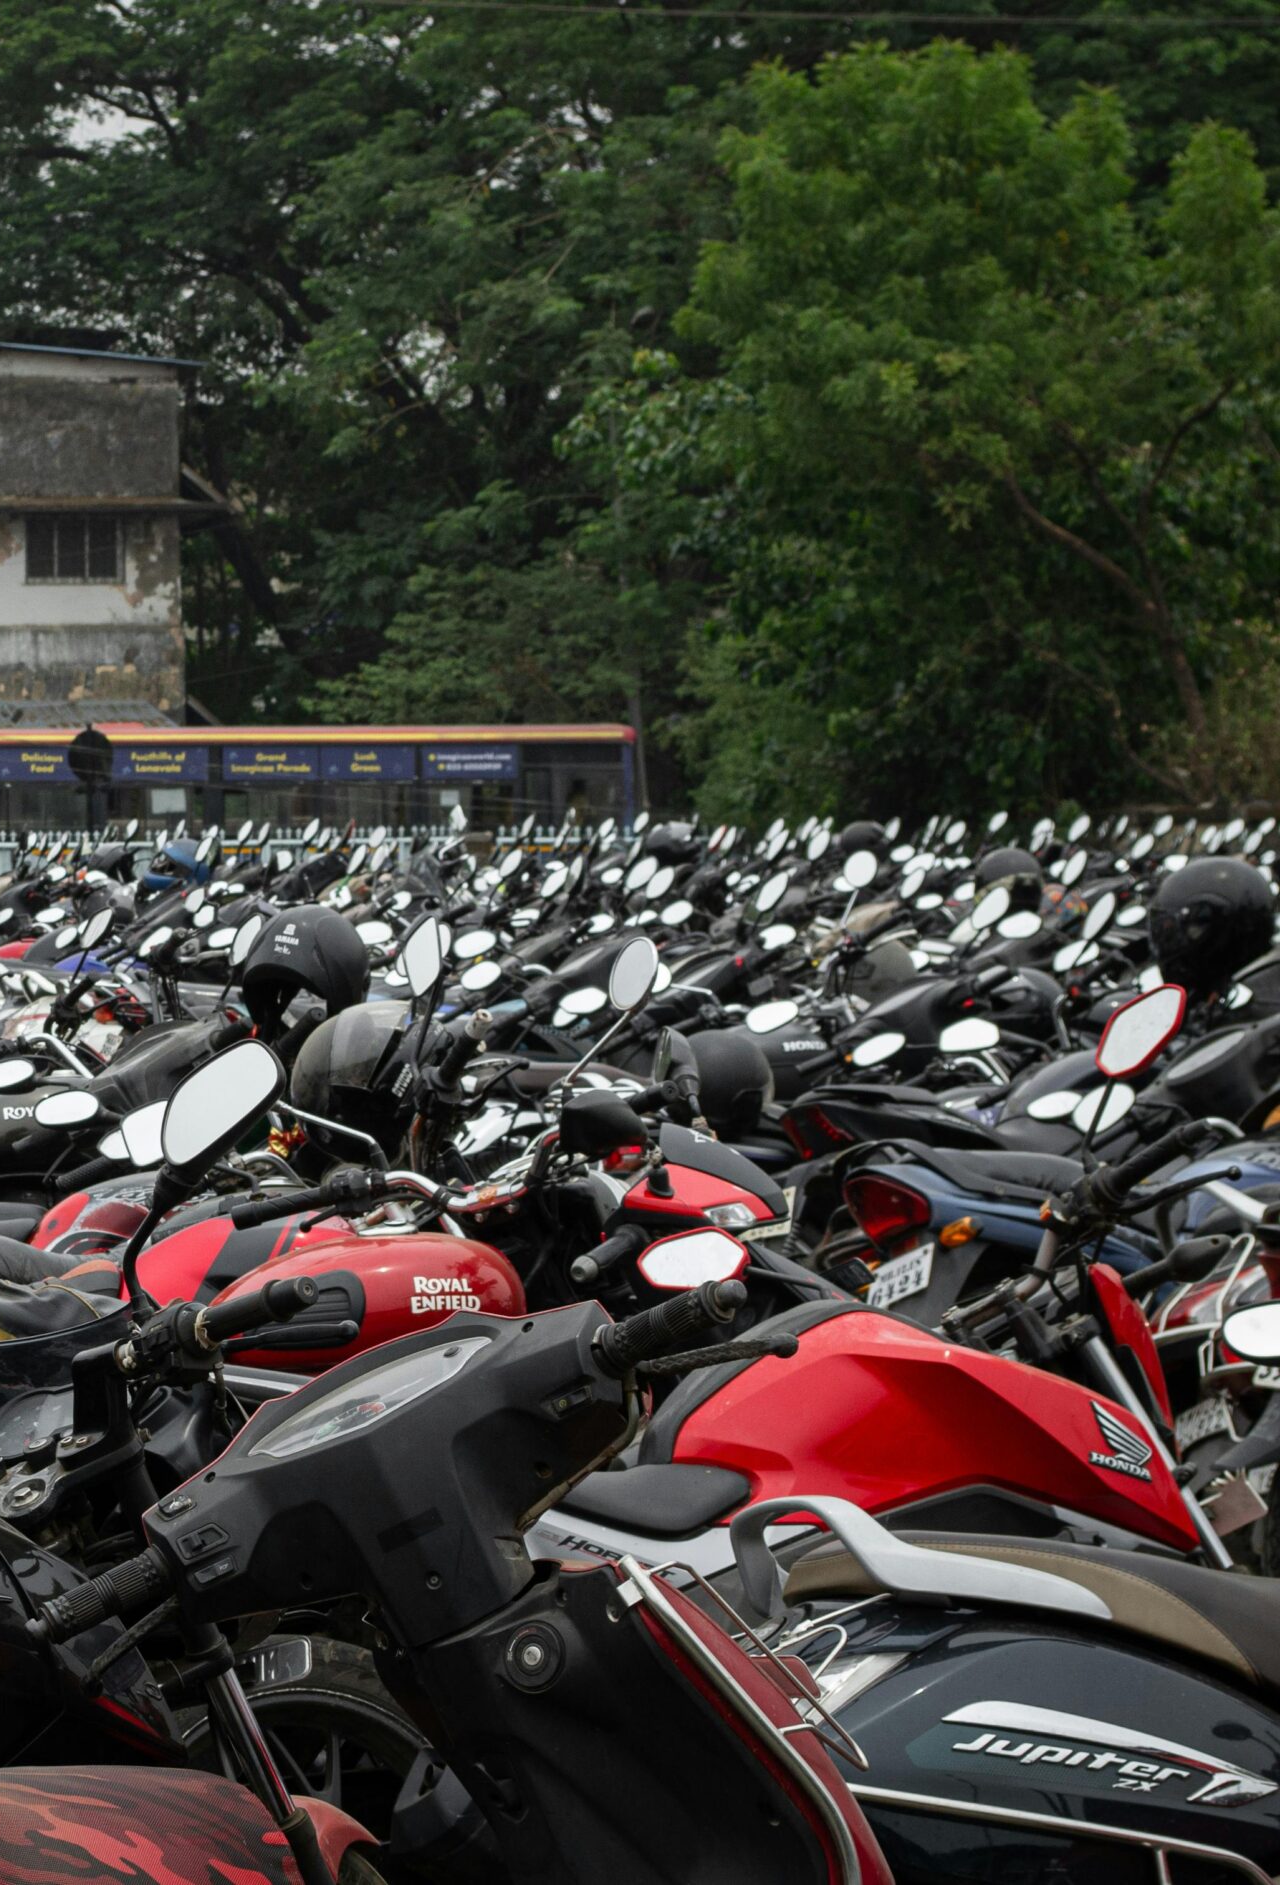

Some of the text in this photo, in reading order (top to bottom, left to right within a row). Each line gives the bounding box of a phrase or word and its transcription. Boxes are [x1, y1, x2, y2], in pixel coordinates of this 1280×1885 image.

[783, 1041, 827, 1052] HOND
[3, 1106, 34, 1120] ROY
[413, 1276, 473, 1294] ROYAL
[411, 1295, 481, 1314] ENFIELD
[1089, 1451, 1152, 1482] HONDA
[558, 1535, 675, 1577] HORT
[1112, 1778, 1160, 1793] ZX
